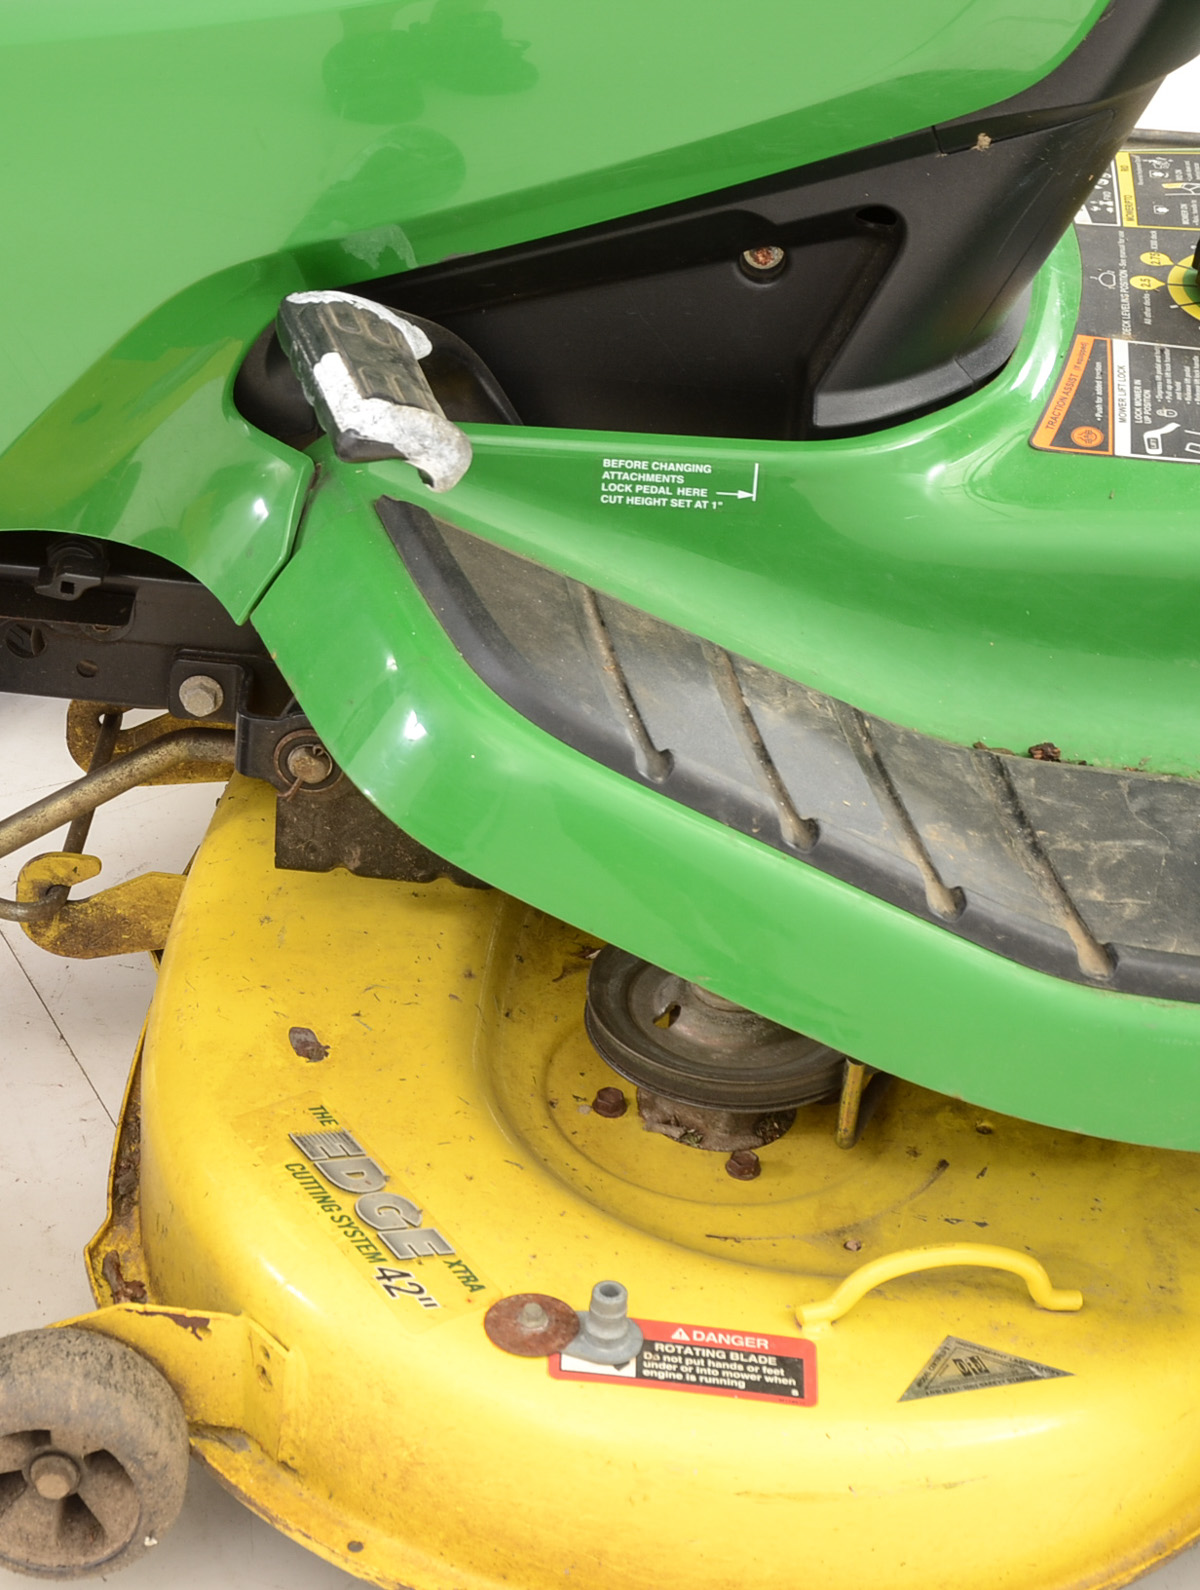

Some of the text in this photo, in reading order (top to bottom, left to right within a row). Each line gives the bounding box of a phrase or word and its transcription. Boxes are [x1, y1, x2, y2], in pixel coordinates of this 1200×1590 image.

[1149, 252, 1161, 265] 2.75
[1119, 269, 1129, 293] POSITION
[1140, 278, 1151, 288] 2.5
[1120, 294, 1131, 320] LEVELING
[1122, 320, 1131, 335] DECK
[1095, 380, 1103, 395] added
[1117, 365, 1127, 423] MOWER LIFT LOCK
[1133, 386, 1142, 406] MOWER
[1045, 396, 1065, 430] TRACTION
[1064, 373, 1079, 397] ASSIST
[1095, 396, 1103, 404] for
[1143, 389, 1152, 424] UP POSITION
[1095, 403, 1103, 418] Push
[1134, 407, 1143, 424] LOCK
[602, 458, 712, 473] BEFORE CHANGING
[602, 471, 684, 484] ATTACHMENTS
[601, 483, 708, 497] LOCK PEDAL HERE
[600, 494, 723, 510] CUT HEIGHT SET AT 1"
[308, 1105, 339, 1126] THE
[288, 1127, 486, 1292] EDGE XTRA
[285, 1162, 440, 1309] CUTTING SYSTEM 42"
[692, 1330, 769, 1350] DANGER
[654, 1342, 777, 1366] ROTATING BLADE
[643, 1352, 785, 1377] Do not put hands or feet
[643, 1361, 677, 1371] under
[696, 1366, 719, 1377] into
[721, 1371, 762, 1381] mower
[764, 1374, 796, 1386] when
[642, 1369, 746, 1389] engine is running
